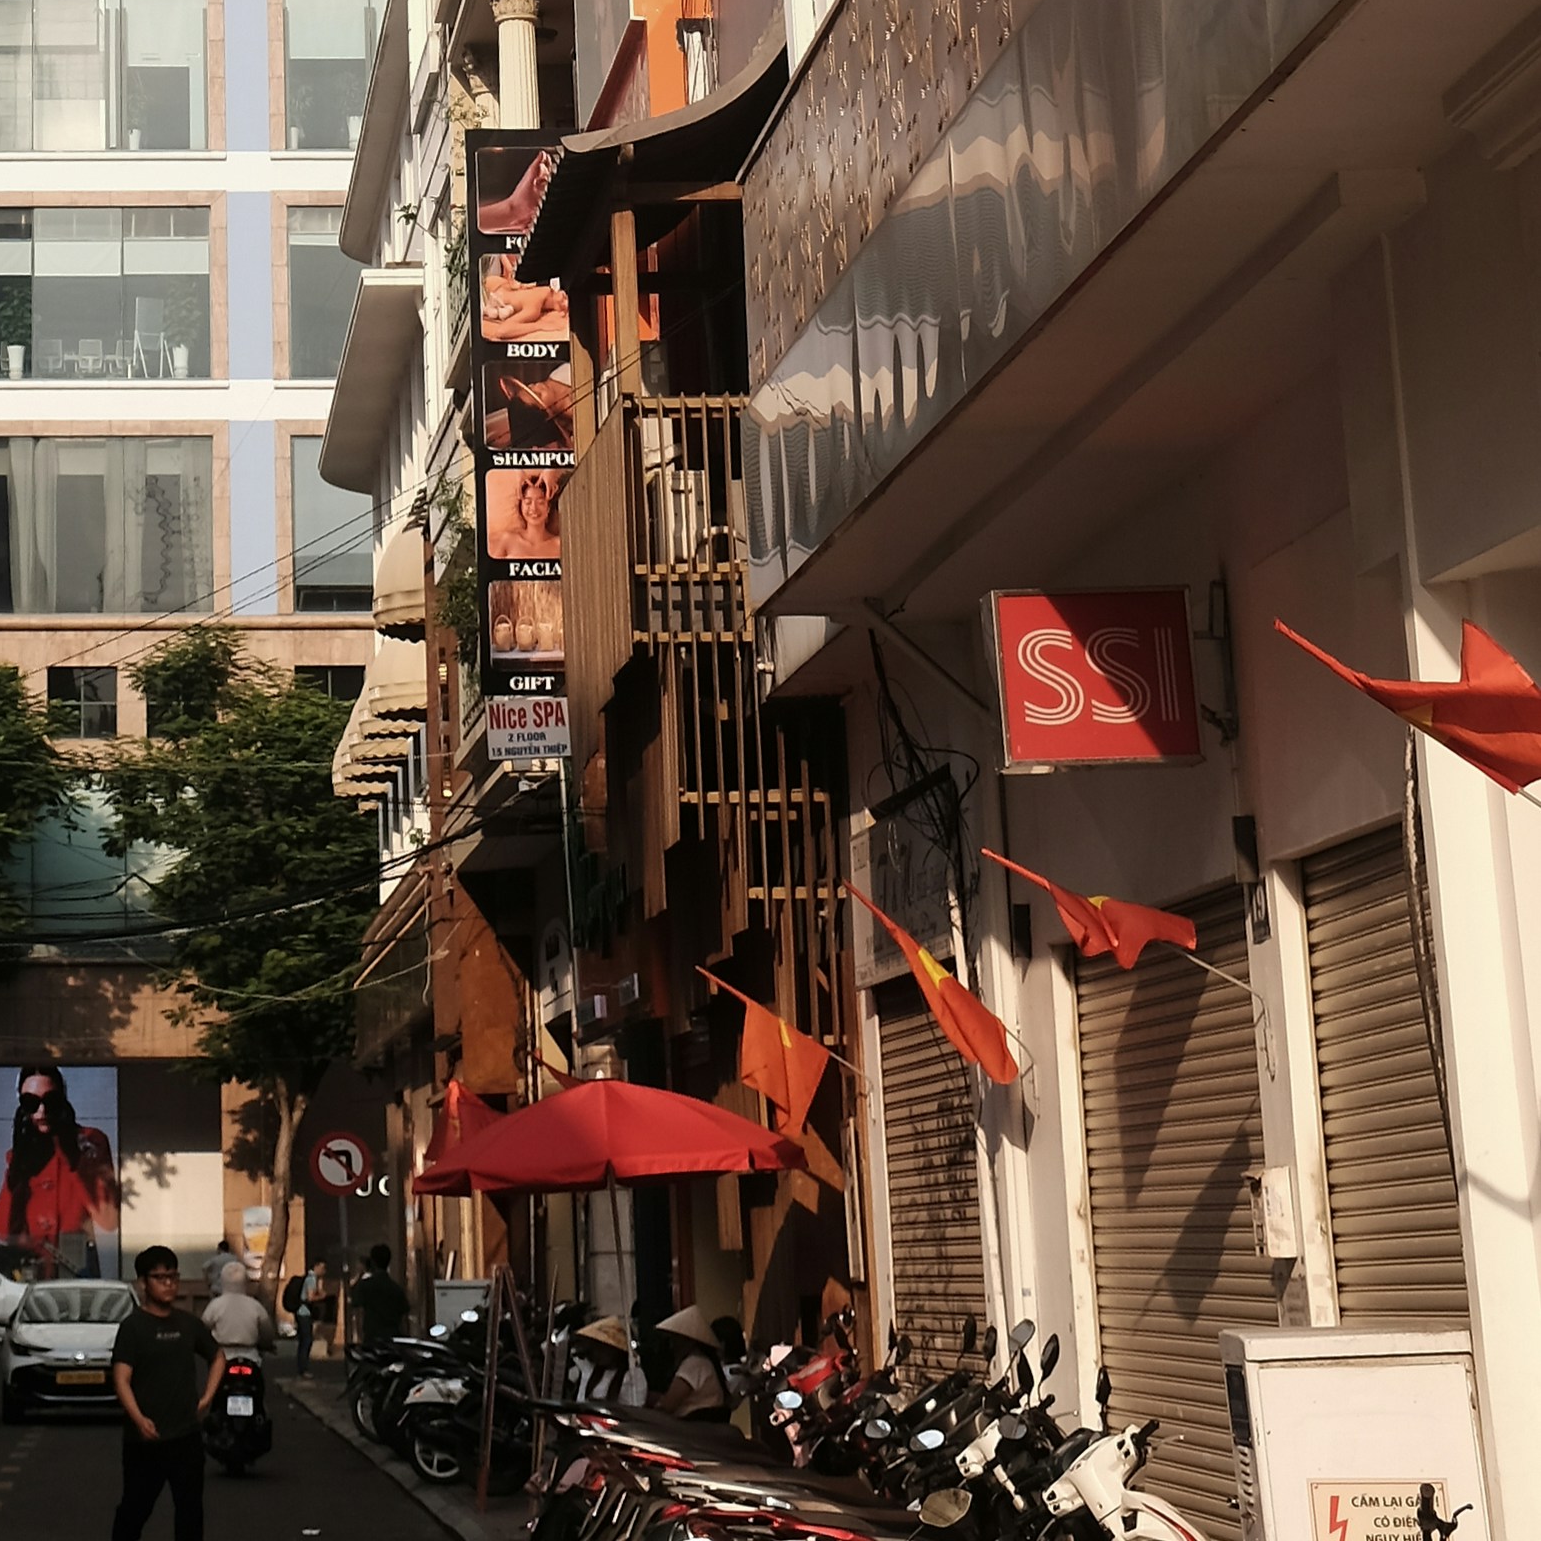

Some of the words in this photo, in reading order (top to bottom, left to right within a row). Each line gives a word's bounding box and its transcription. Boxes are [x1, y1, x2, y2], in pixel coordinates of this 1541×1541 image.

[507, 343, 560, 358] BODY
[509, 676, 555, 691] GIFT
[1017, 627, 1181, 726] SSI
[488, 703, 527, 730] Nice
[532, 701, 566, 728] SPA
[508, 733, 514, 742] 2
[516, 732, 547, 742] FLOOR
[491, 746, 502, 757] 15
[1383, 1496, 1402, 1510] LẠI
